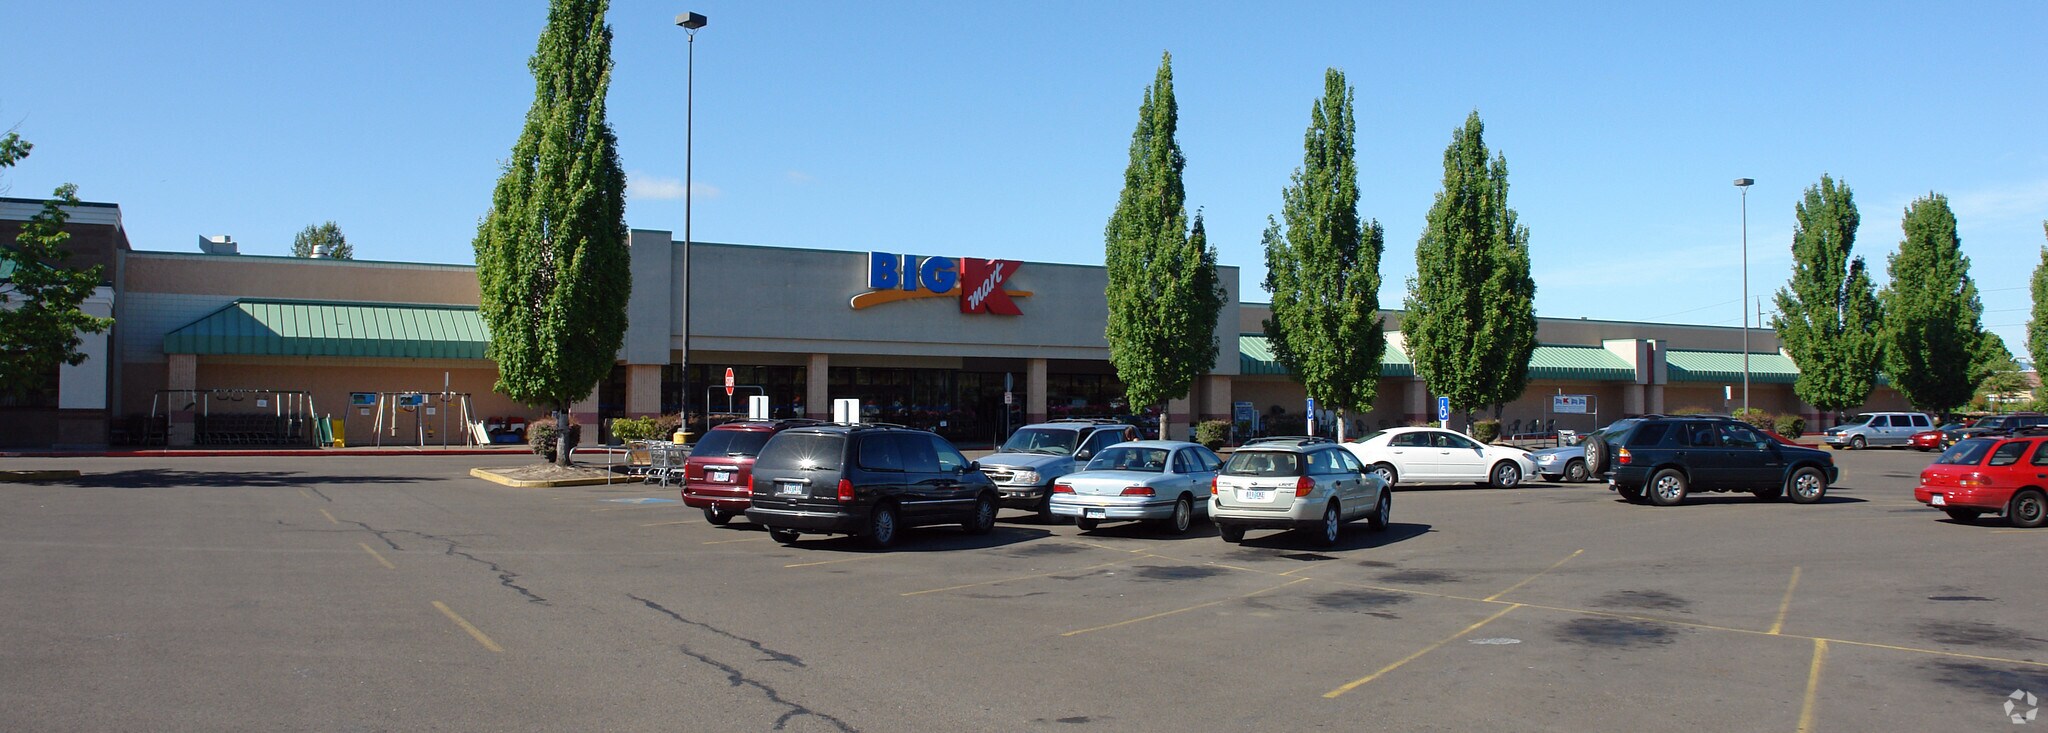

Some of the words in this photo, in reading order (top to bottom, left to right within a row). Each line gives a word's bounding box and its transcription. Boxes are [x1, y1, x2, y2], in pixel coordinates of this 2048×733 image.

[867, 251, 957, 293] BIG
[960, 257, 1025, 315] K
[967, 262, 1004, 310] mart
